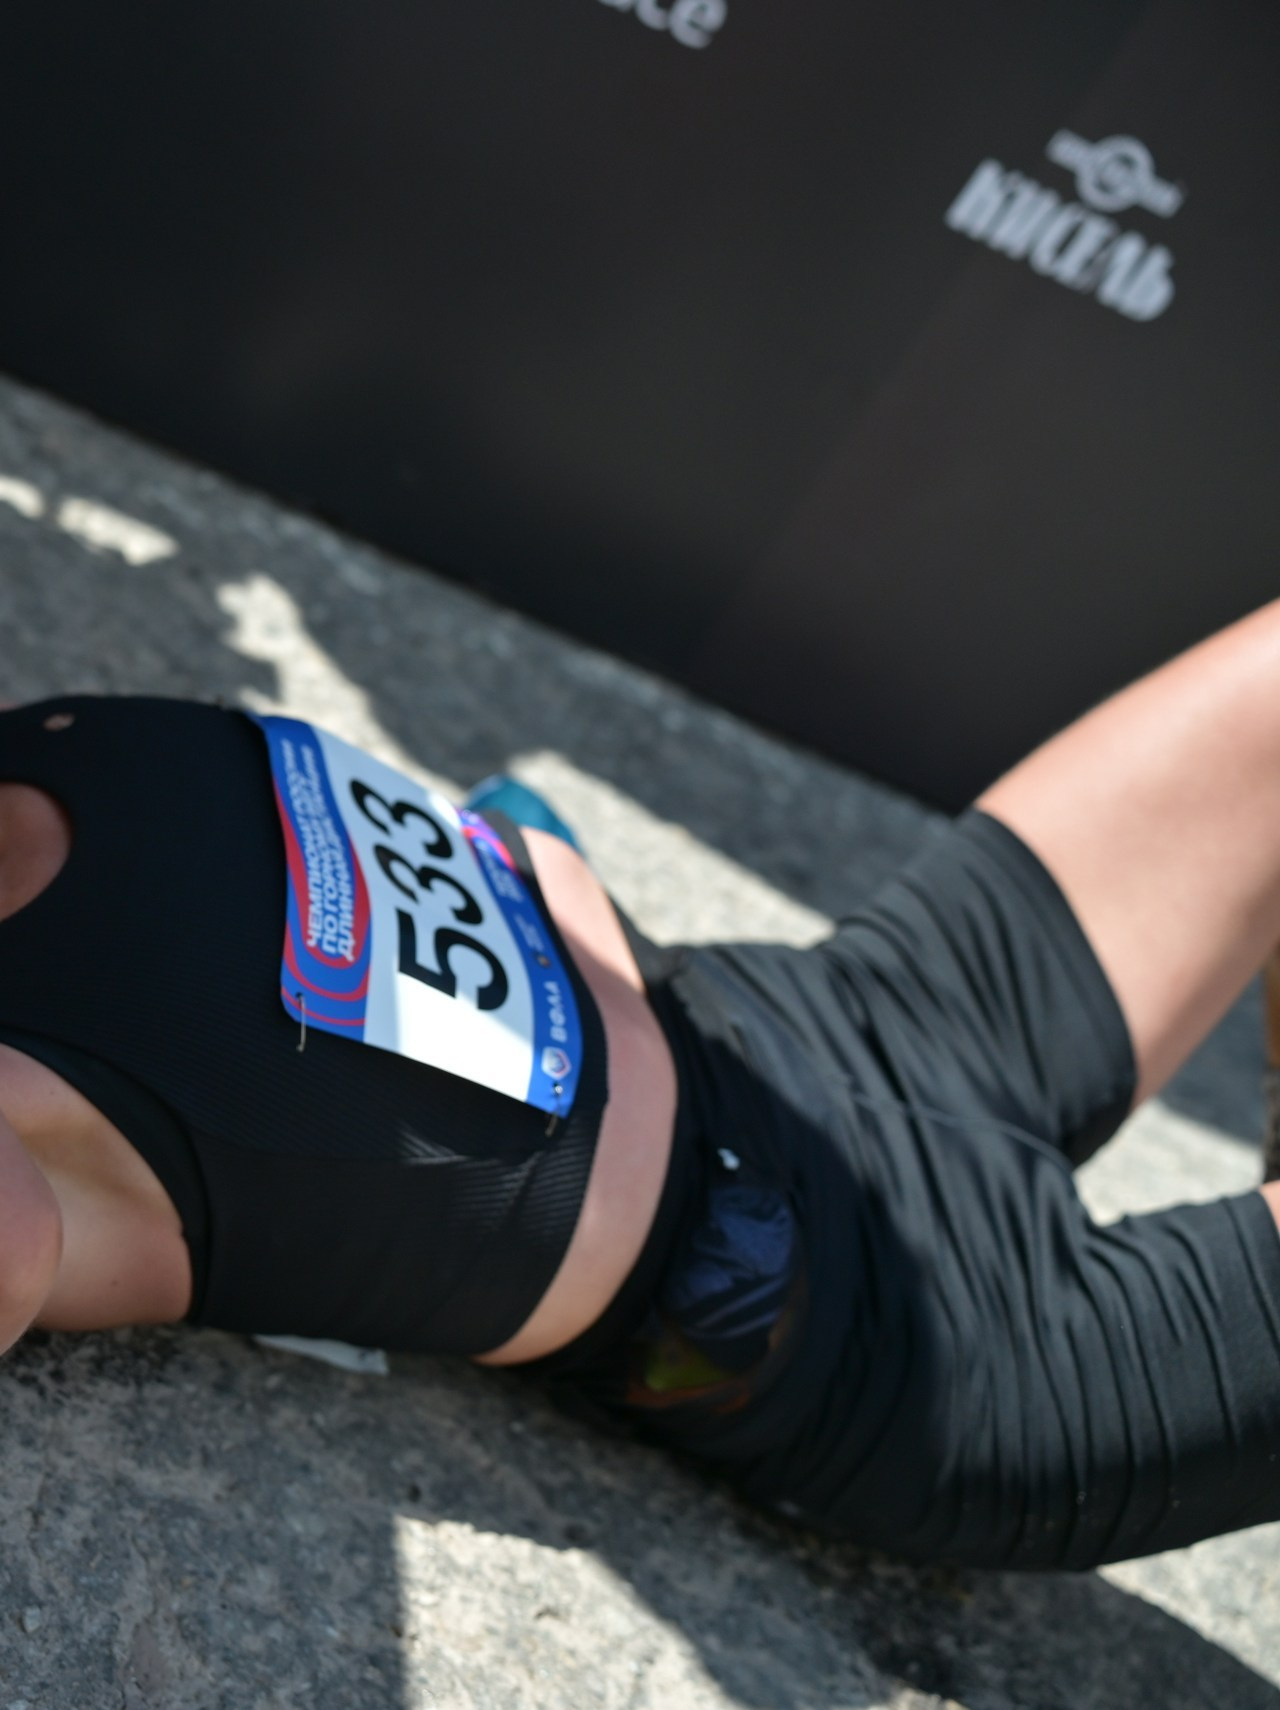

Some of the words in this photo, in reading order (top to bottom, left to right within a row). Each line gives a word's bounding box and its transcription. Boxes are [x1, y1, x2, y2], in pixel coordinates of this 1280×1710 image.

[945, 157, 1174, 321] КИСЕЛЬ
[322, 914, 338, 954] ПО
[350, 779, 509, 1011] 533
